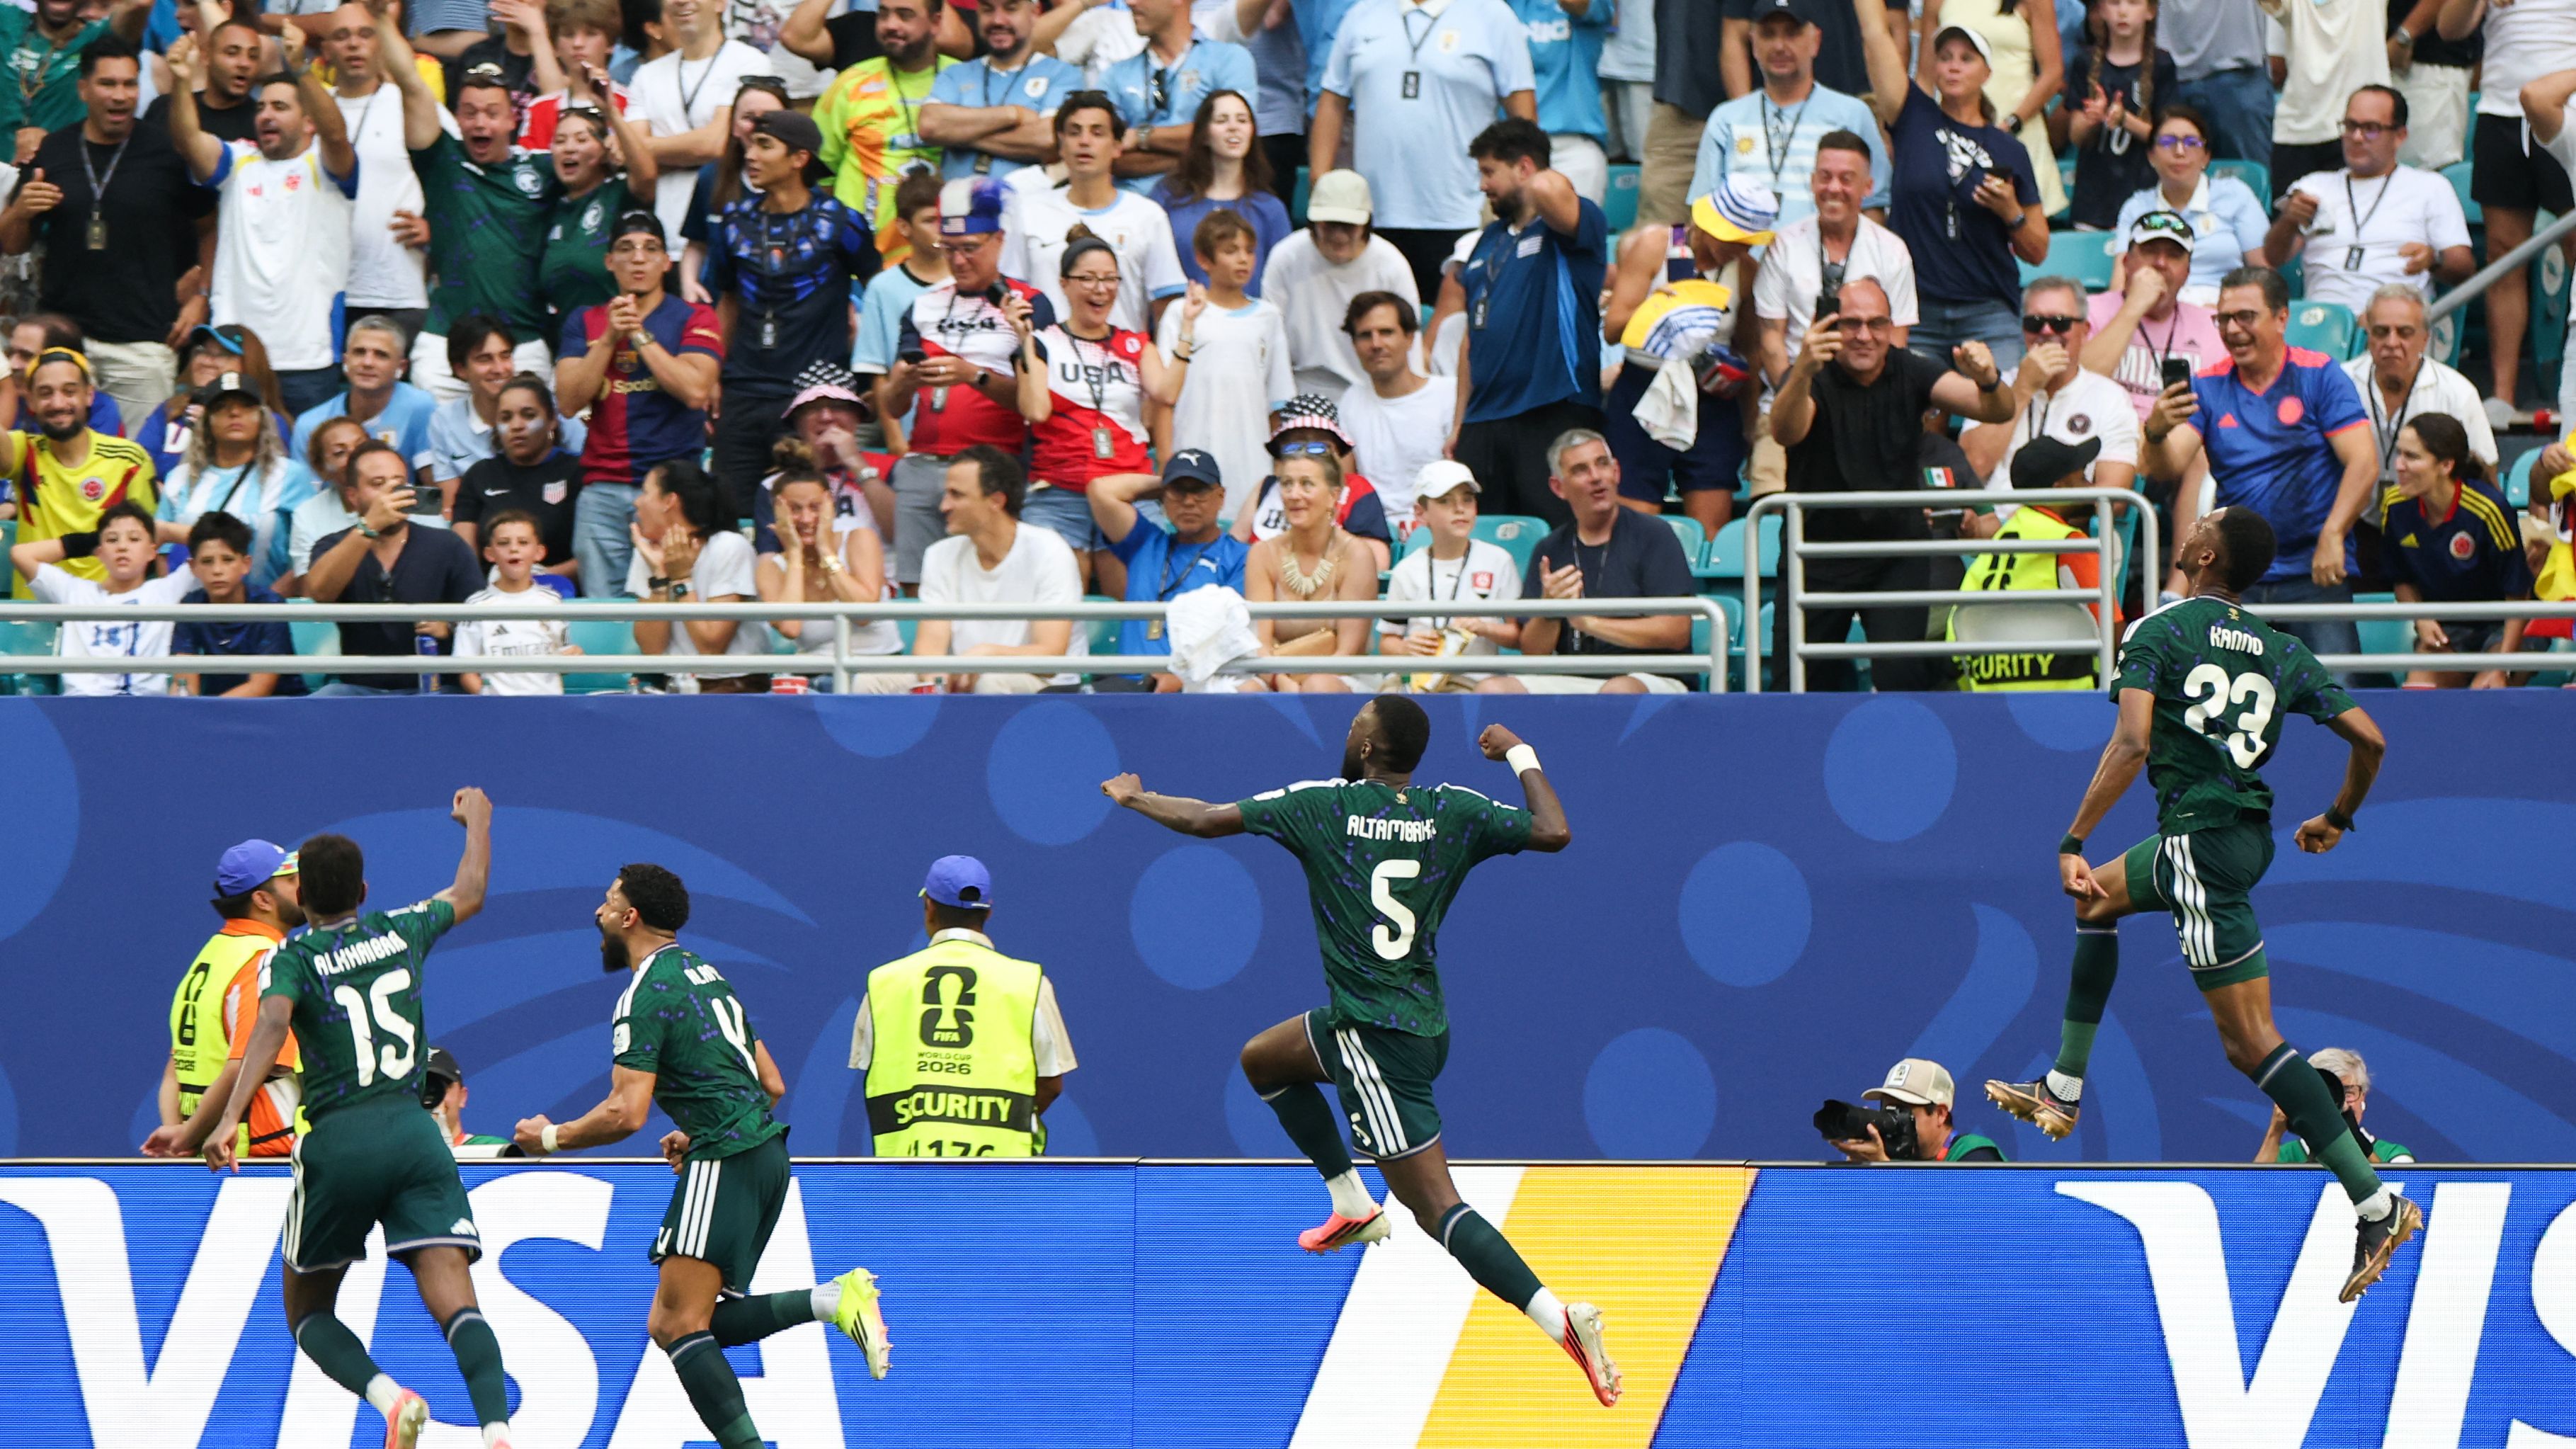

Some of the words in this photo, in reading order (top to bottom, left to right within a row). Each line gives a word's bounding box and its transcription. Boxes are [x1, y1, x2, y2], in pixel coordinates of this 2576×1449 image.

[1060, 361, 1127, 385] USA
[2114, 344, 2201, 390] MIAI
[2210, 625, 2264, 656] KANNO
[2183, 663, 2276, 769] 23
[1370, 859, 1421, 960] 5
[334, 967, 415, 1087] 15
[933, 1030, 961, 1042] FIFA
[917, 1061, 971, 1075] 2026
[894, 1091, 1012, 1125] SCURITY
[0, 1171, 846, 1449] VISA
[2053, 1181, 2576, 1449] VI
